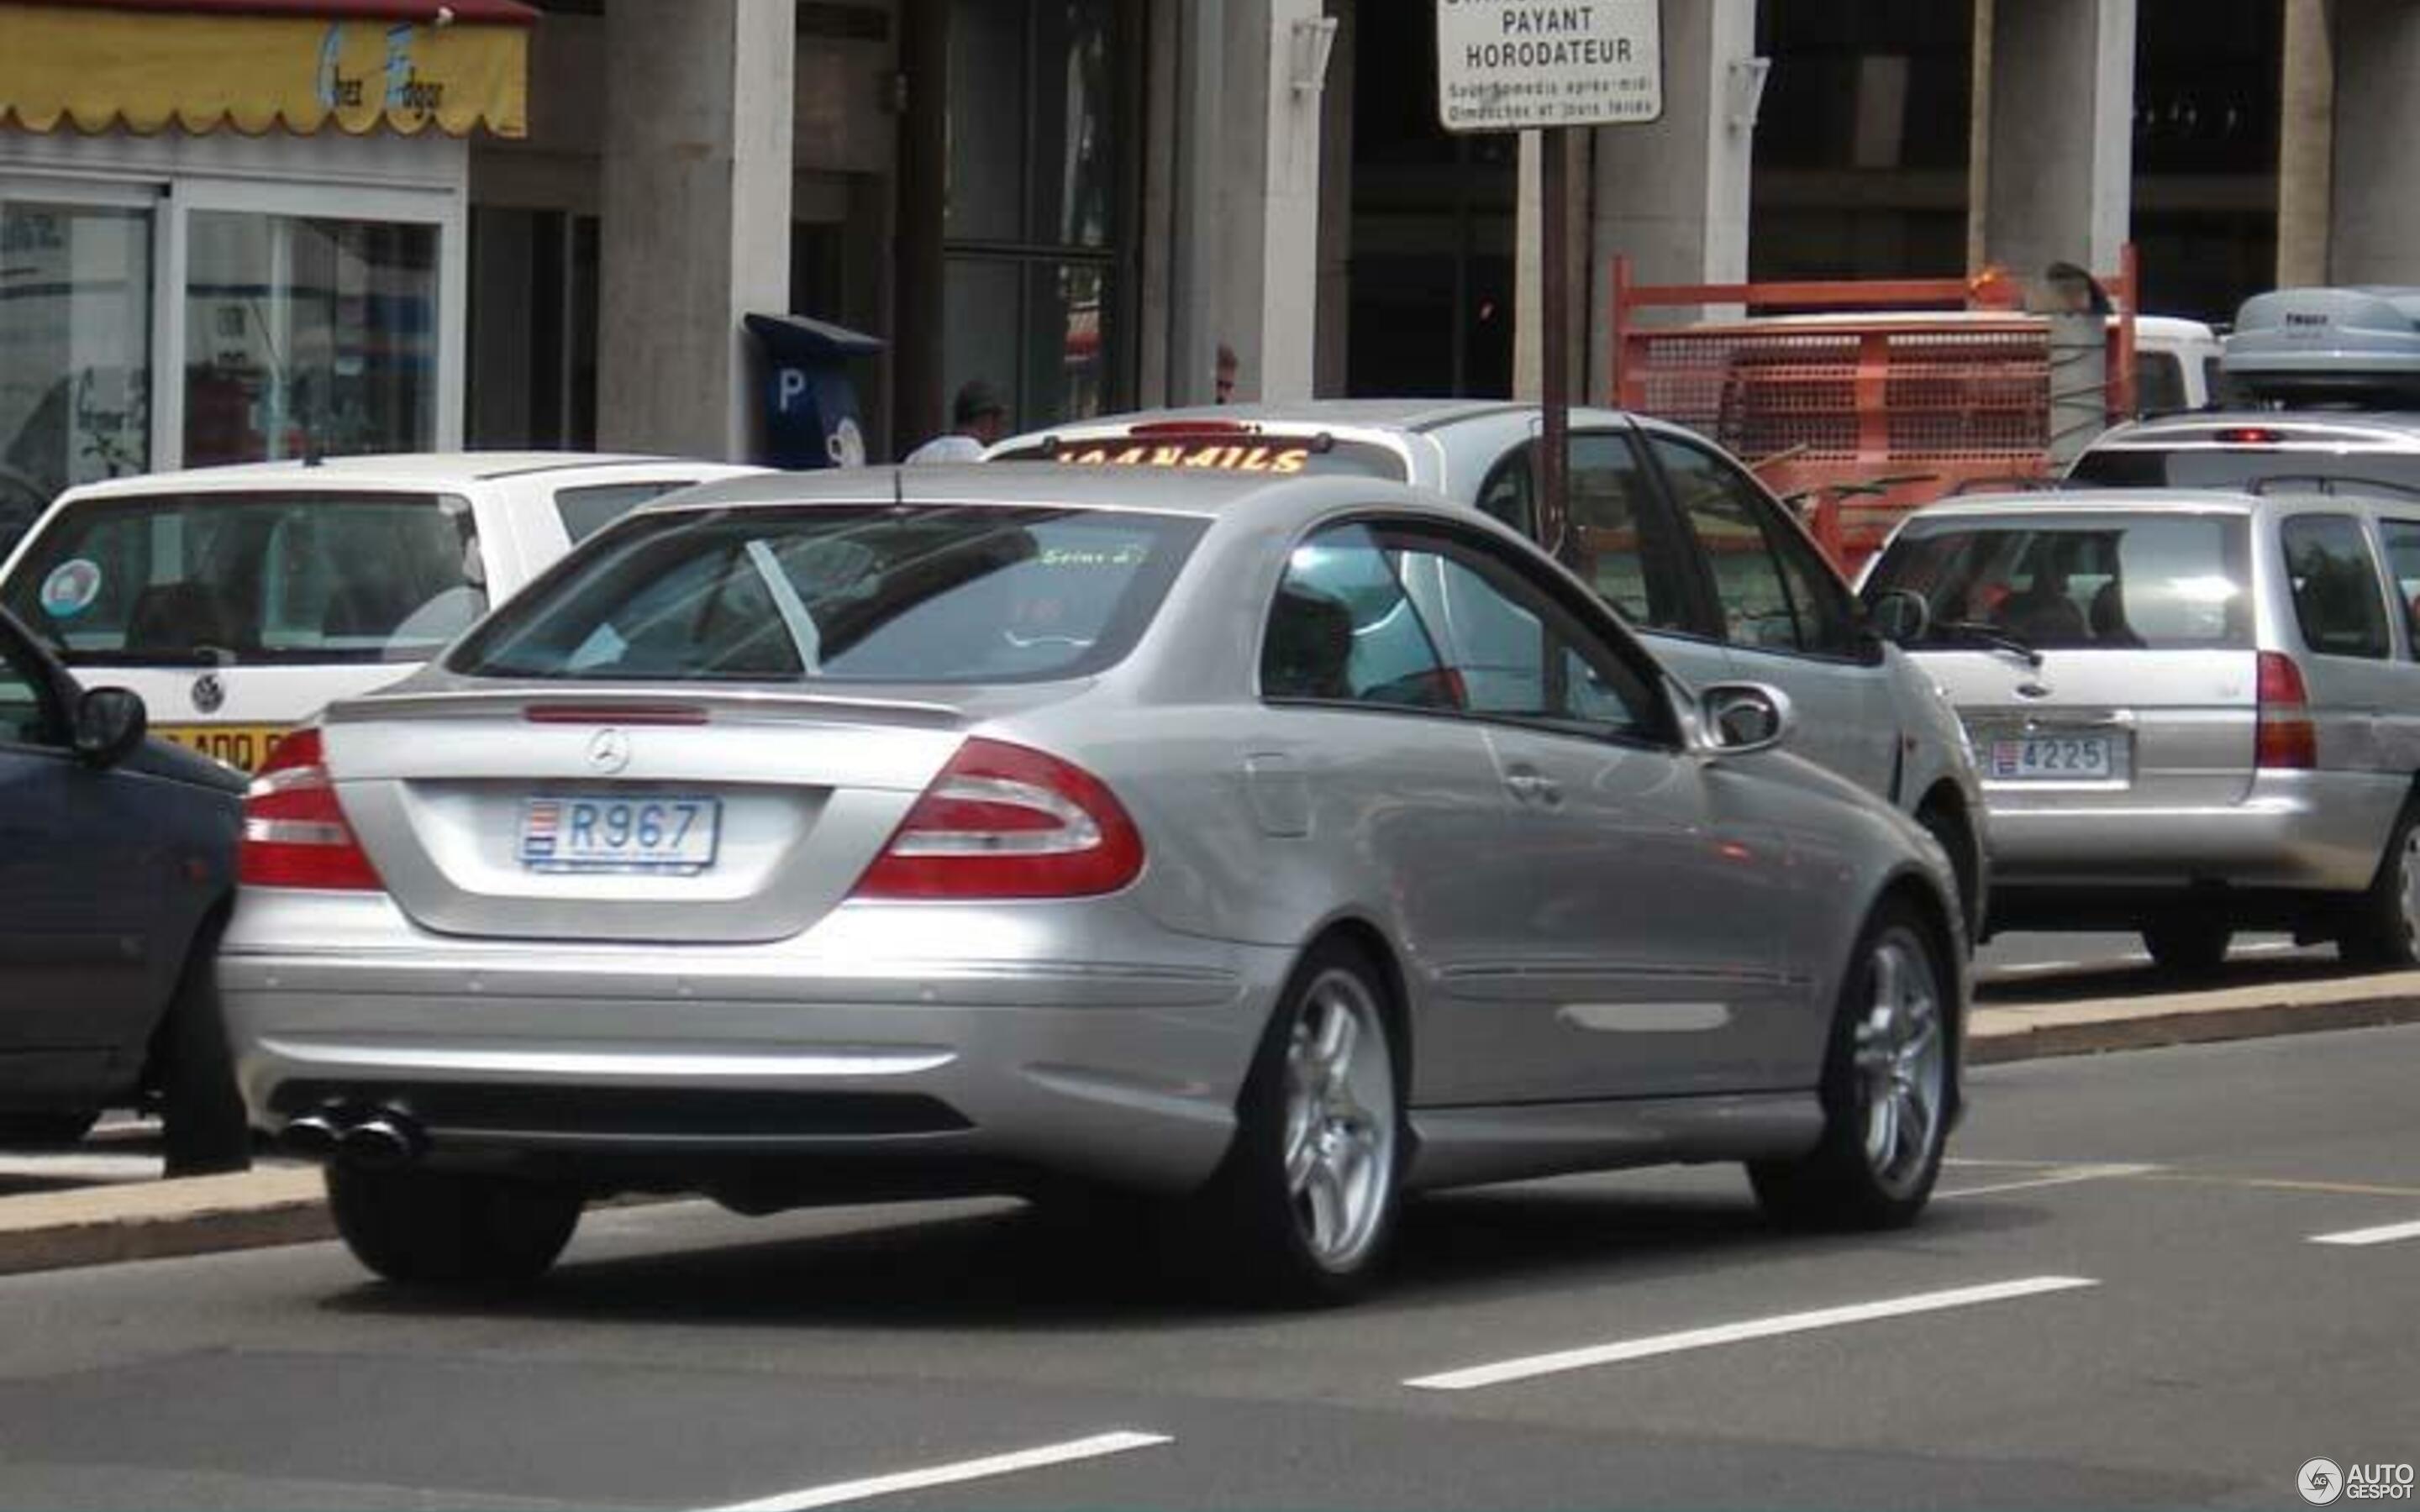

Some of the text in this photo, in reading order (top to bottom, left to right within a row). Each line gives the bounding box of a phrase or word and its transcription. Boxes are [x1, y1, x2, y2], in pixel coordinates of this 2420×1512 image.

[1502, 7, 1592, 34] PAYANT
[1466, 39, 1633, 67] HORODATEUR
[779, 368, 805, 412] P
[2023, 738, 2102, 769] 4225
[571, 803, 699, 848] R967
